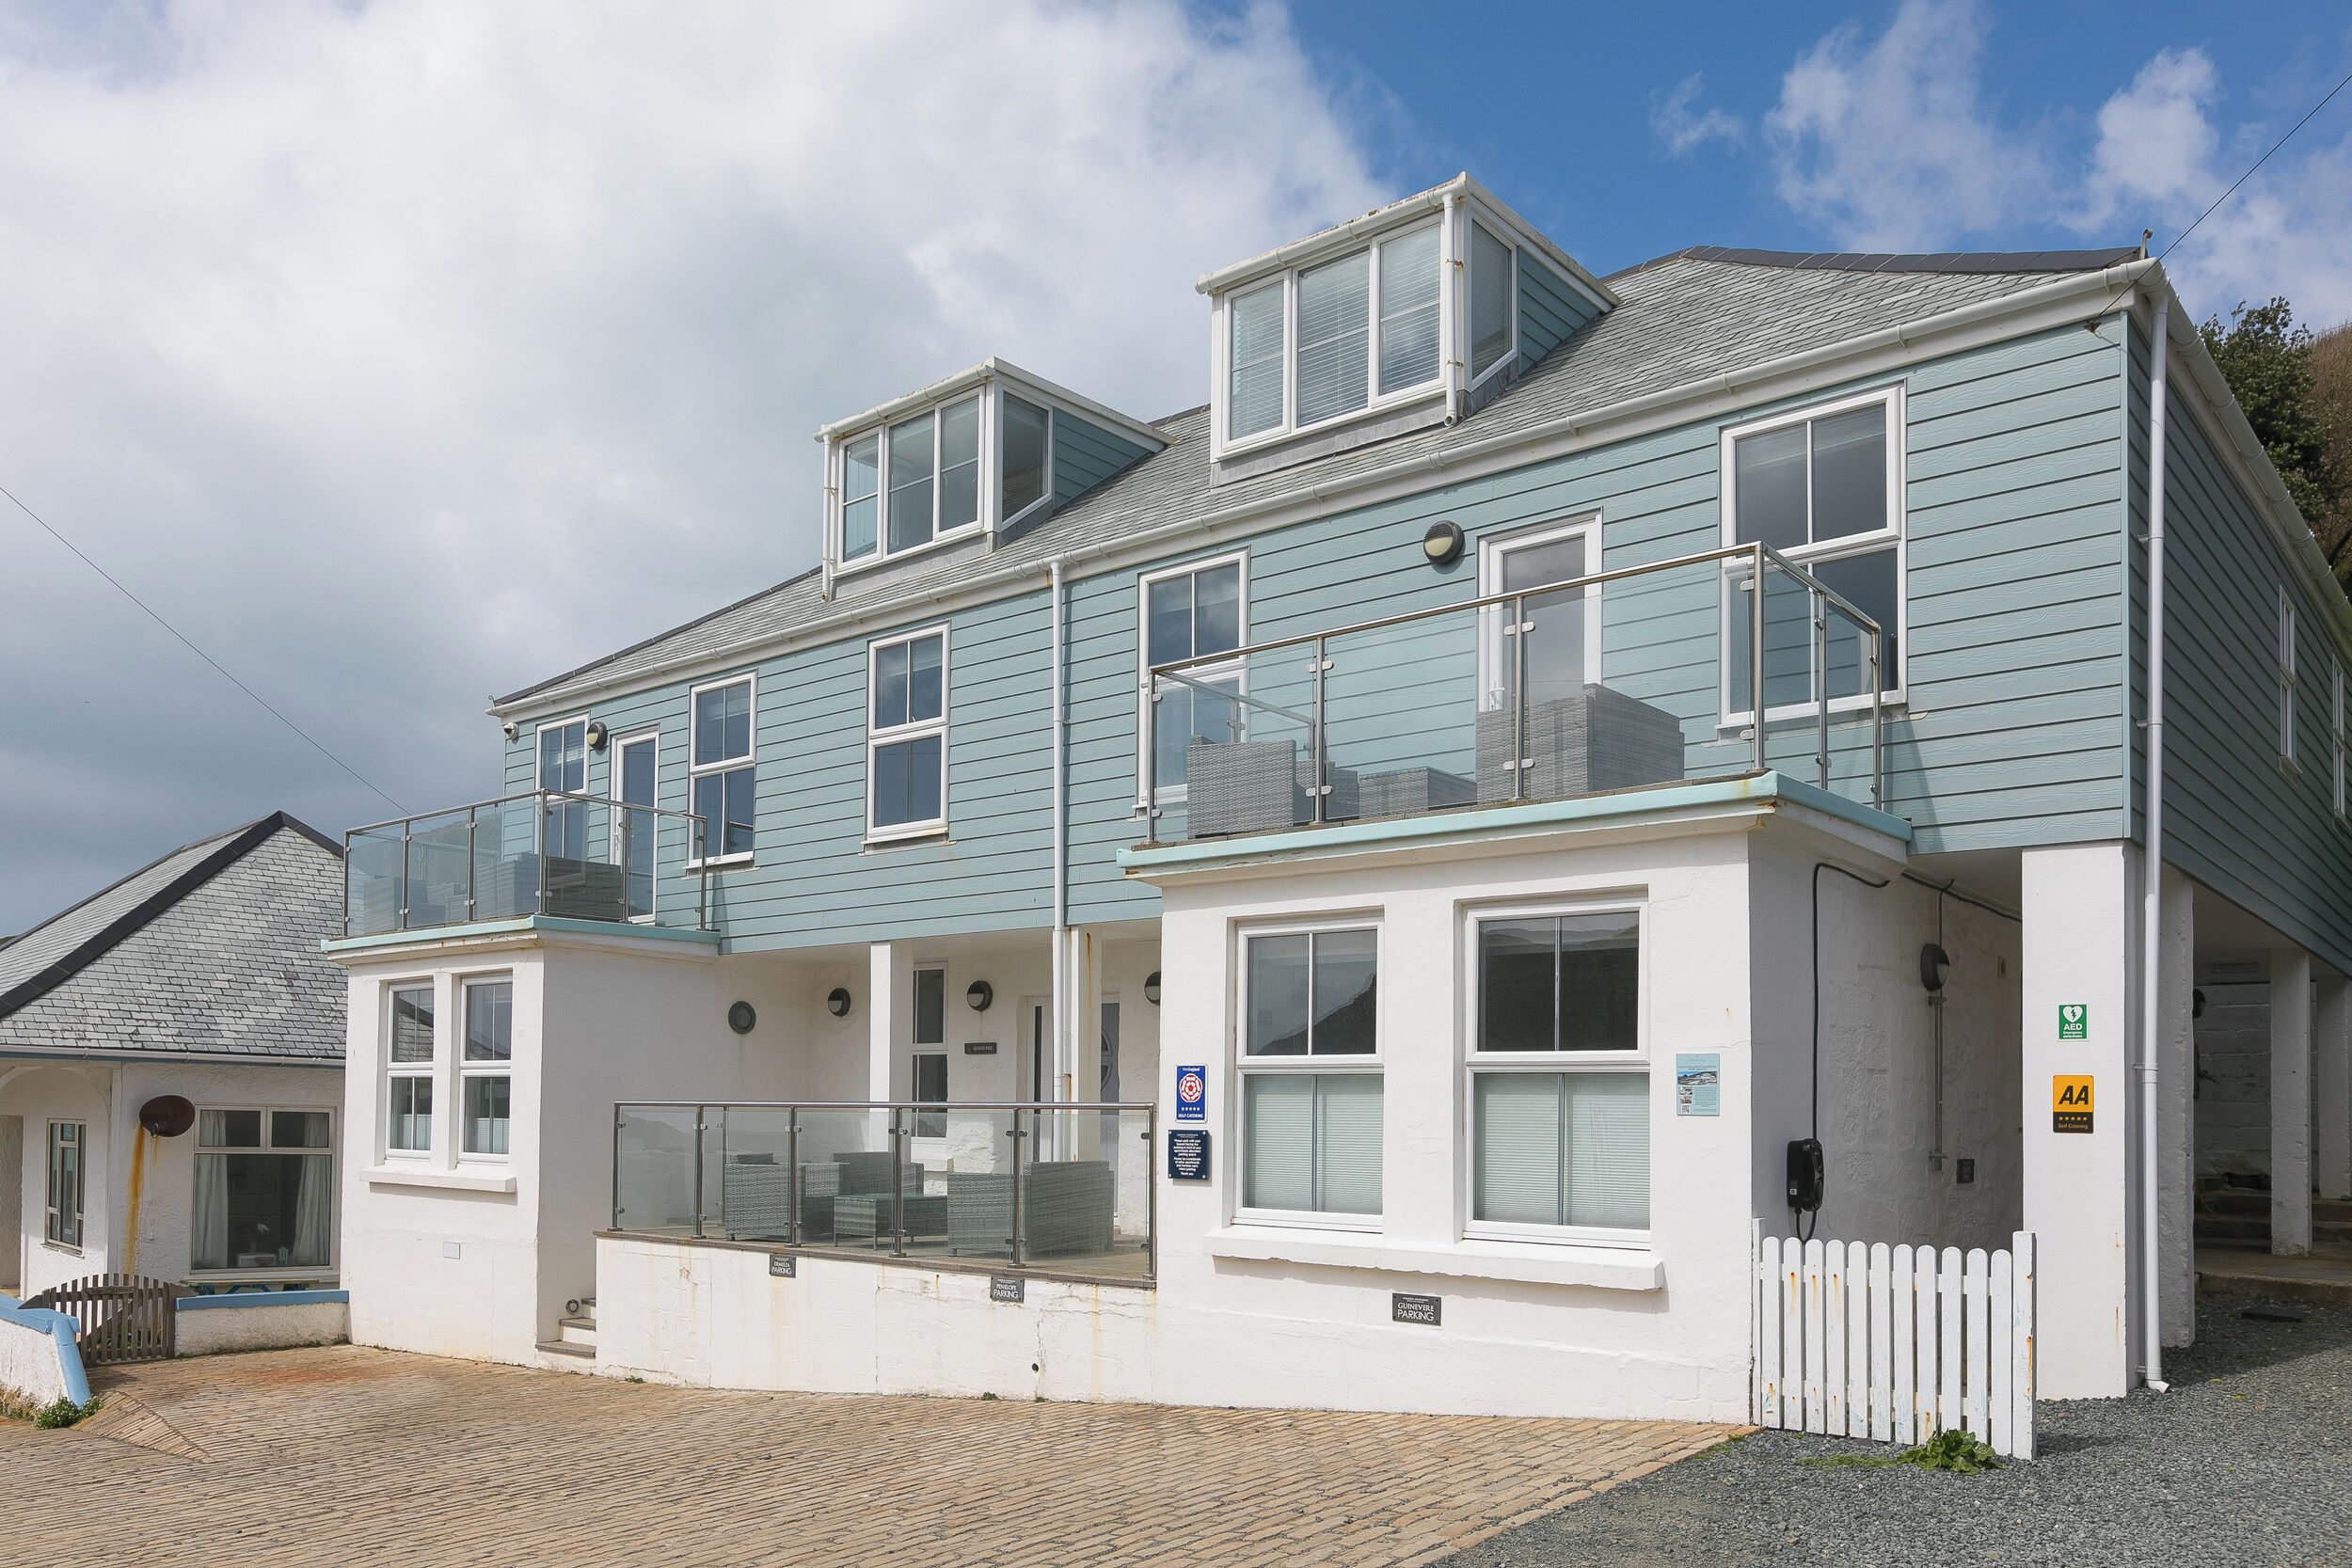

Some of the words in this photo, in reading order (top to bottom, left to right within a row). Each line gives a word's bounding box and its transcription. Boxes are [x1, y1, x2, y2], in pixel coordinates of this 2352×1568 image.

[2058, 1085, 2089, 1104] AA
[771, 1266, 791, 1275] PARKING
[993, 1289, 1019, 1298] PARKING
[1397, 1303, 1435, 1312] GUINEVERE
[1397, 1309, 1435, 1322] PARKING
